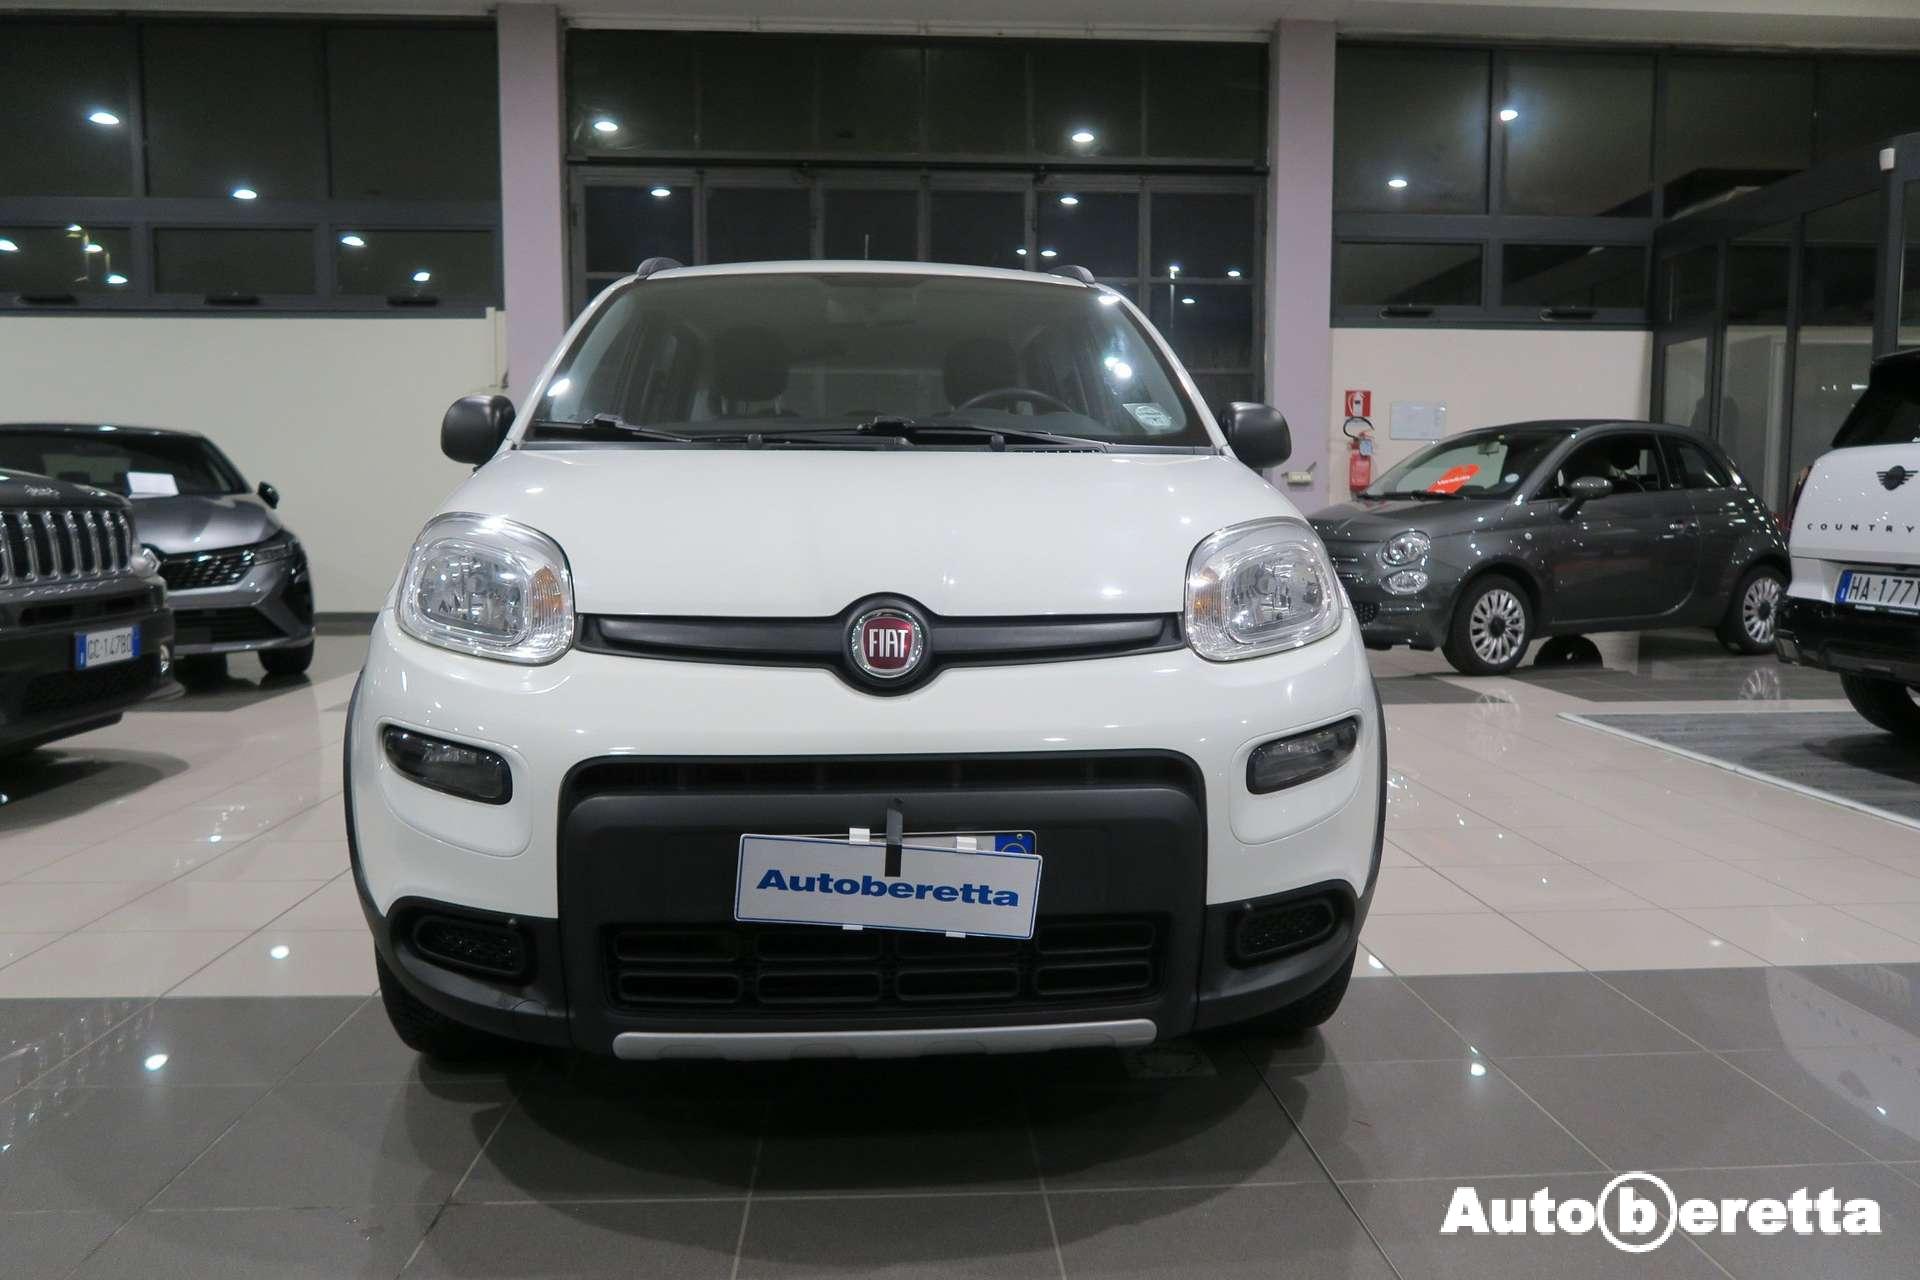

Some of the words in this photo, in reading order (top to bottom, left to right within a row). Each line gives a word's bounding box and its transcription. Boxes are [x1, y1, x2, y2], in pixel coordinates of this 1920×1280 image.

[1807, 522, 1915, 533] COUNTRY
[869, 628, 909, 658] FIAT
[756, 869, 1020, 907] Autoberetta
